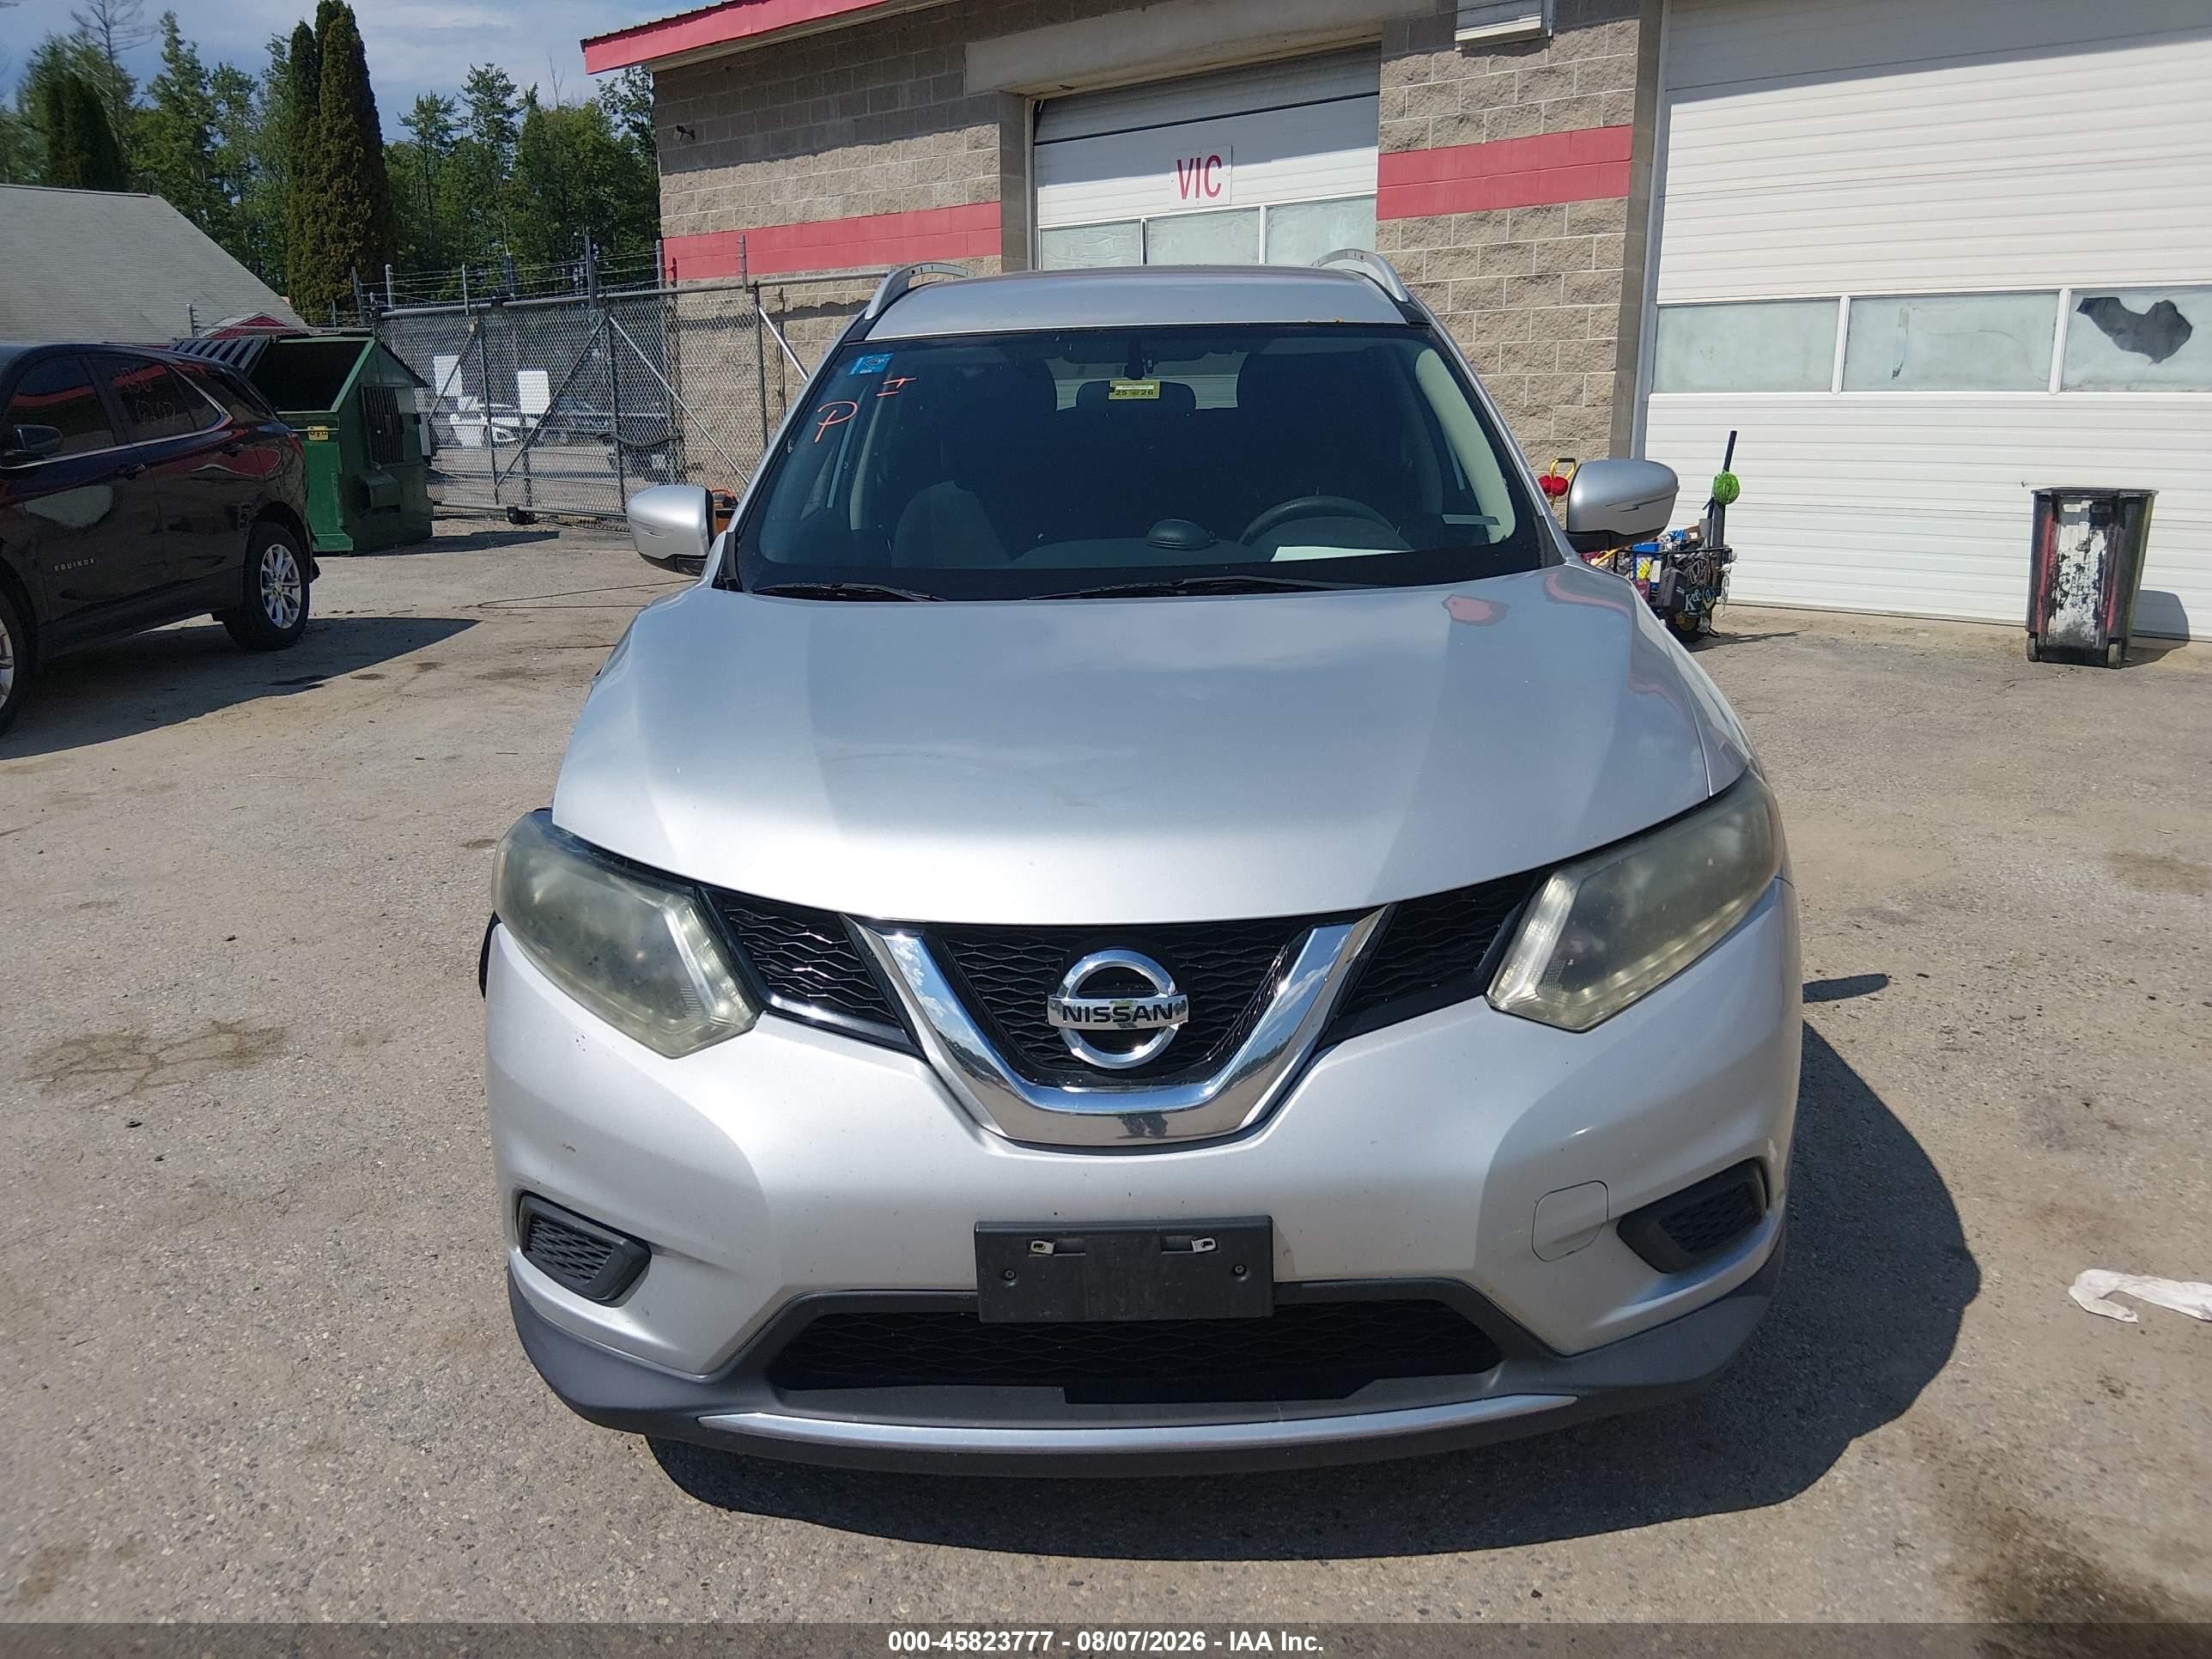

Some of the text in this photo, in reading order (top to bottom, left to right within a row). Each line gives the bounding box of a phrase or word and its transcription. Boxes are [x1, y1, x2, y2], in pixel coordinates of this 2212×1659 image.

[1176, 155, 1223, 199] VIC
[54, 558, 94, 571] EQUINOX
[1062, 1002, 1173, 1023] NISSAN
